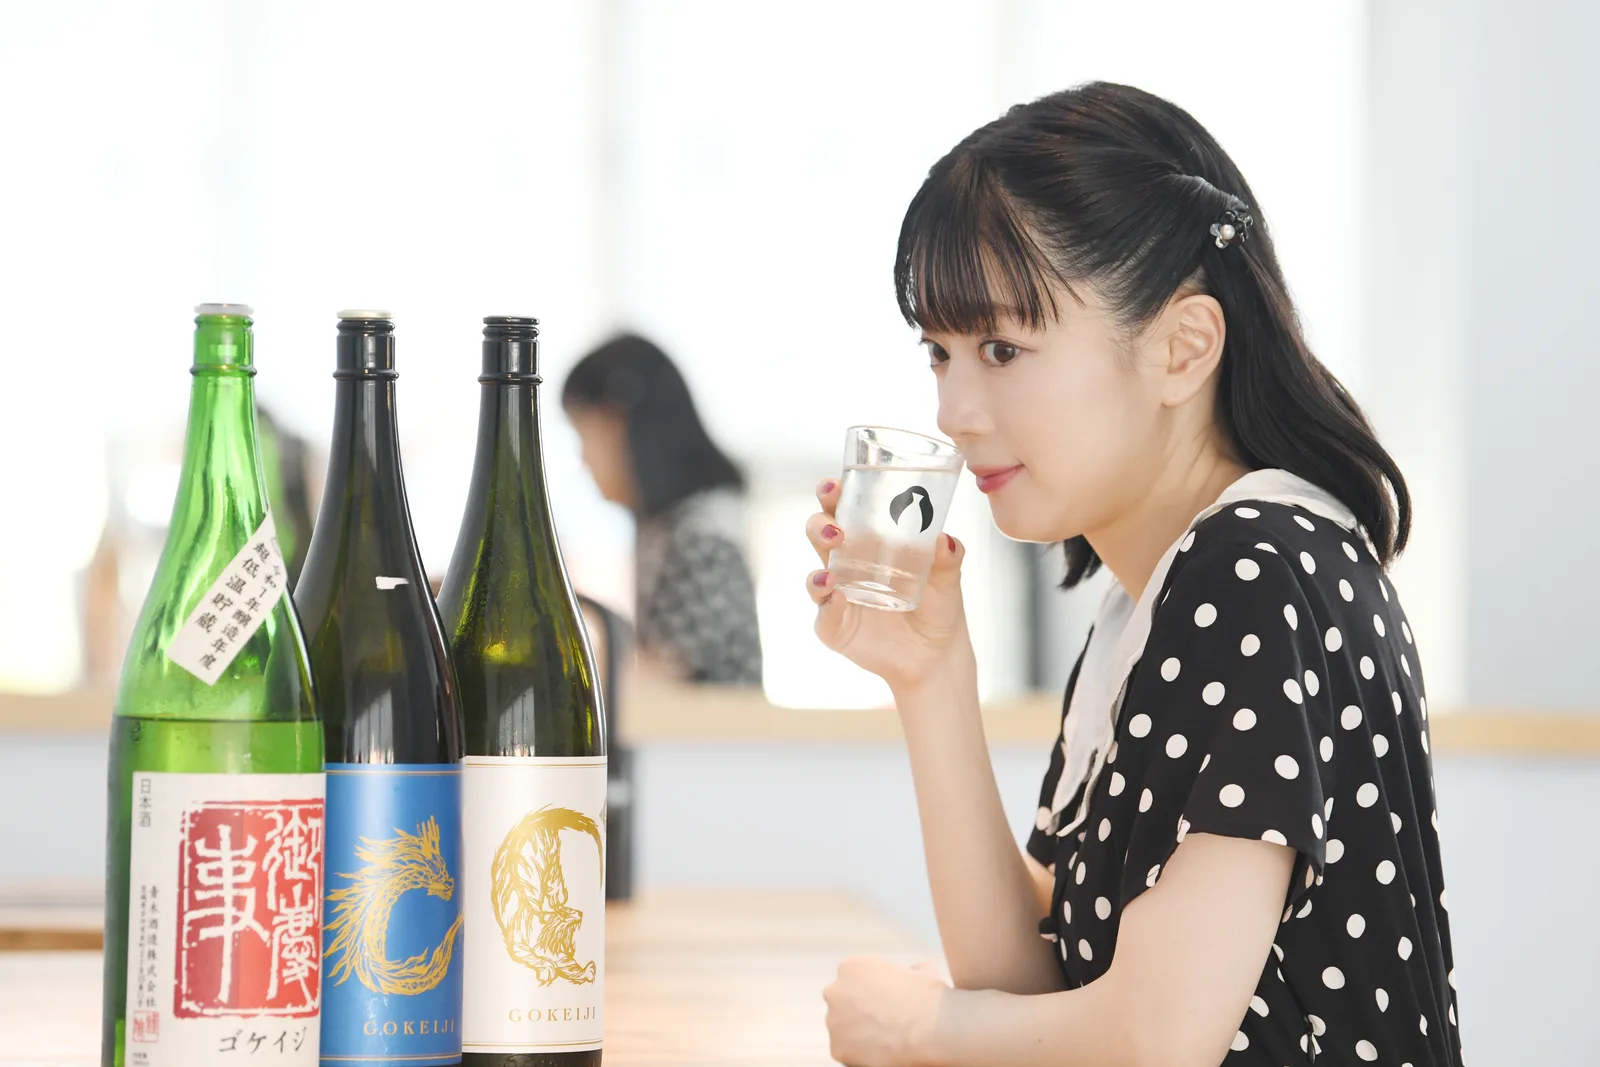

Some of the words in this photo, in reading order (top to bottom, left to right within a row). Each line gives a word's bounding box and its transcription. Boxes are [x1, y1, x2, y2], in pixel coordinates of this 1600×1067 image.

[194, 541, 270, 633] 超低温貯蔵
[138, 779, 152, 828] 日本酒
[363, 1019, 456, 1036] GOKEIJI
[508, 1006, 597, 1022] GOKEIJI
[218, 1026, 308, 1054] ゴケイジ
